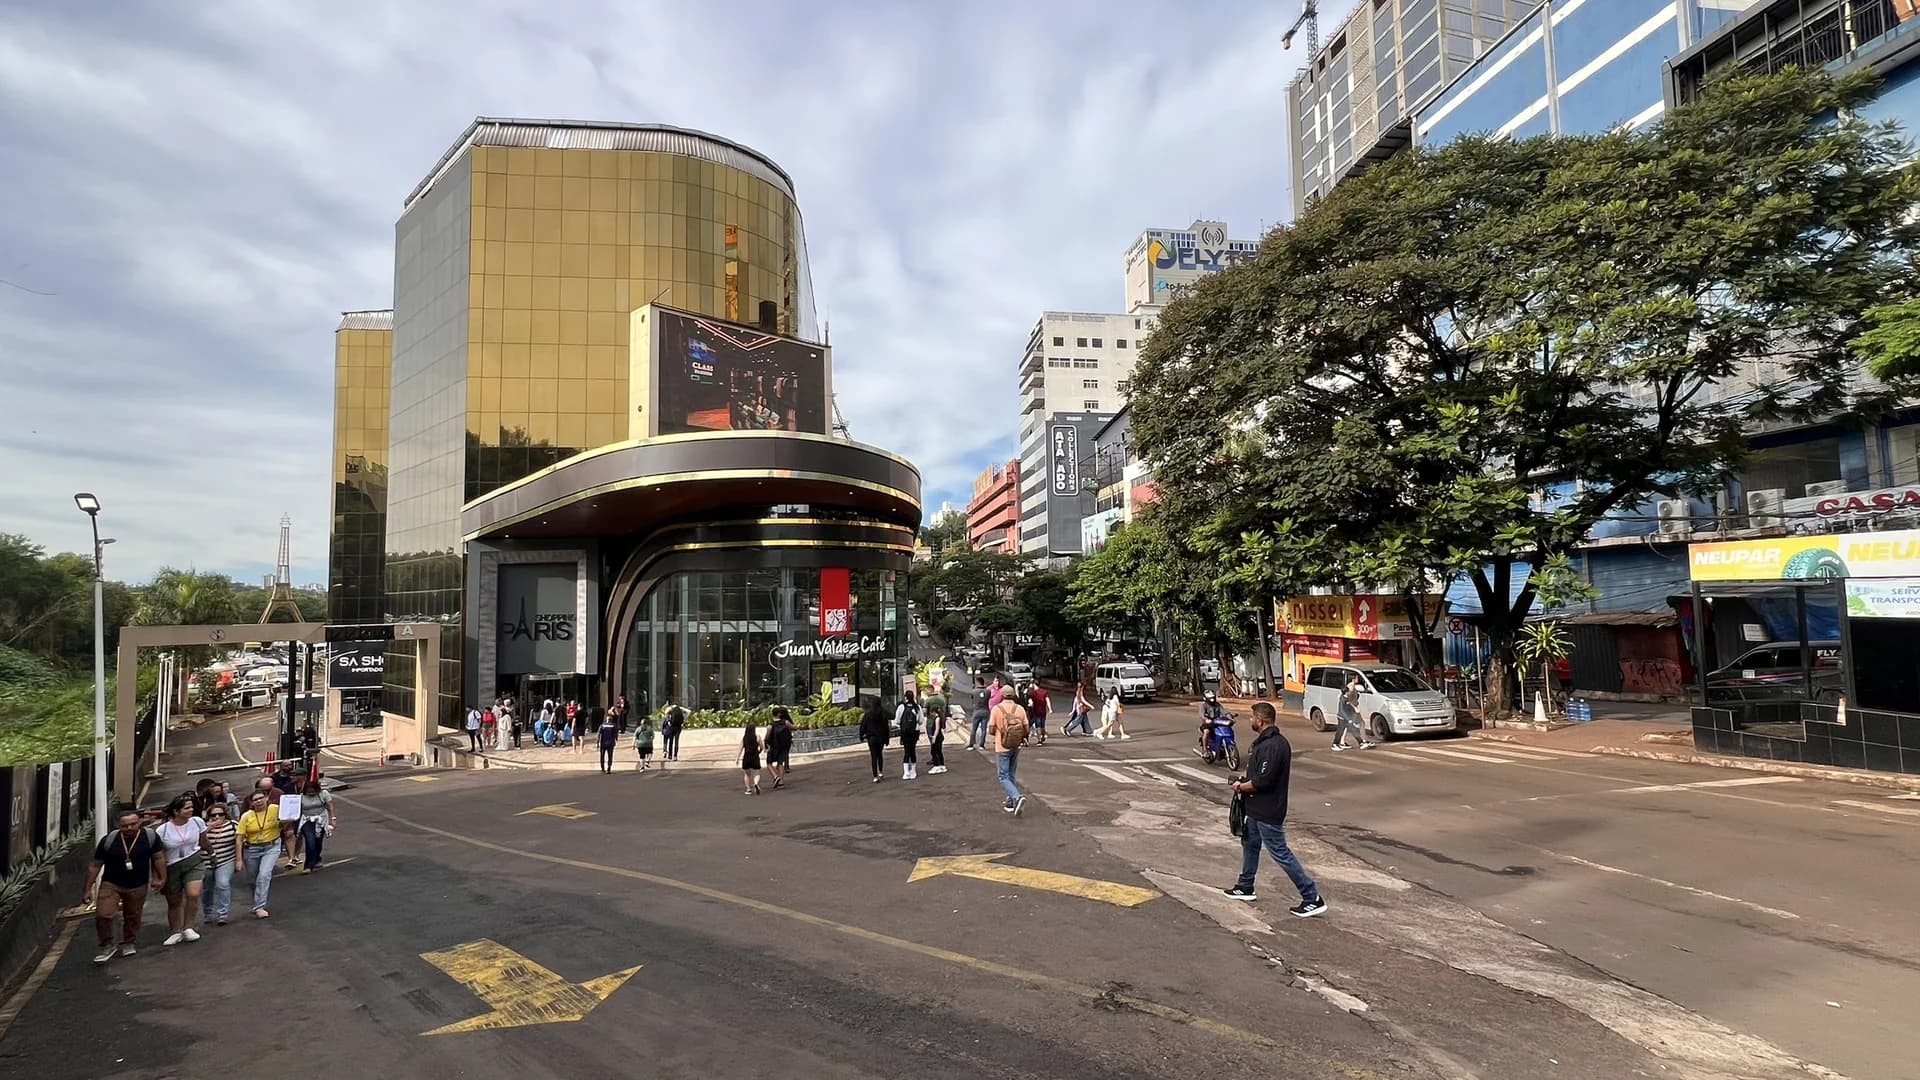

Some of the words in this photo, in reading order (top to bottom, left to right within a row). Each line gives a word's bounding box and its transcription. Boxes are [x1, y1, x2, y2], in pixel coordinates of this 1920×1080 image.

[1815, 490, 1920, 517] CASA
[1694, 548, 1782, 565] NEUPAR
[1293, 603, 1344, 620] nissei
[775, 640, 814, 657] Juan
[815, 636, 860, 656] Valdez
[861, 636, 886, 653] Café
[1015, 634, 1033, 643] FLY
[339, 656, 358, 667] SA
[1817, 649, 1837, 657] FLY
